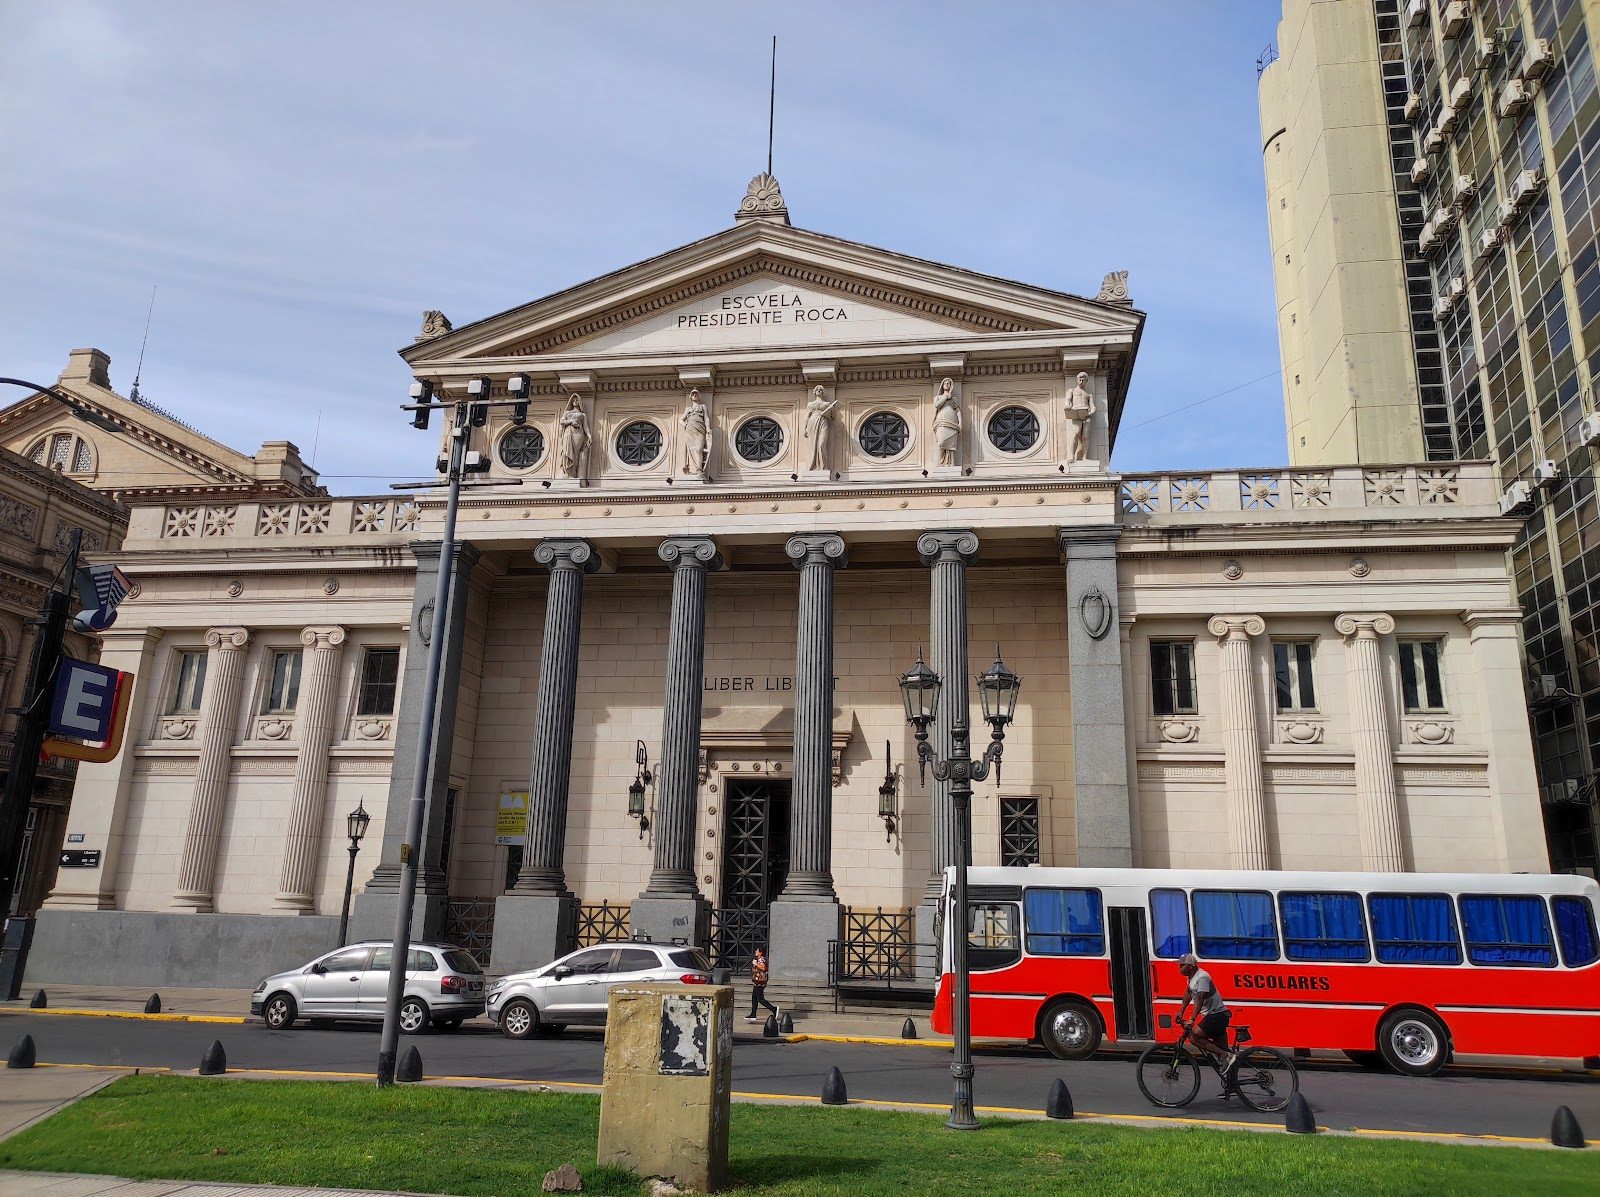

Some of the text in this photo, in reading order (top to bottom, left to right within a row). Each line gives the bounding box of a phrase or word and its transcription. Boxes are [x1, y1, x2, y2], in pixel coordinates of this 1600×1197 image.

[722, 294, 802, 310] ESCVELA
[678, 308, 848, 328] PRESIDENTE ROCA
[704, 677, 839, 691] LIBER LIBT
[60, 666, 108, 733] E
[1233, 974, 1331, 991] ESCOLARES
